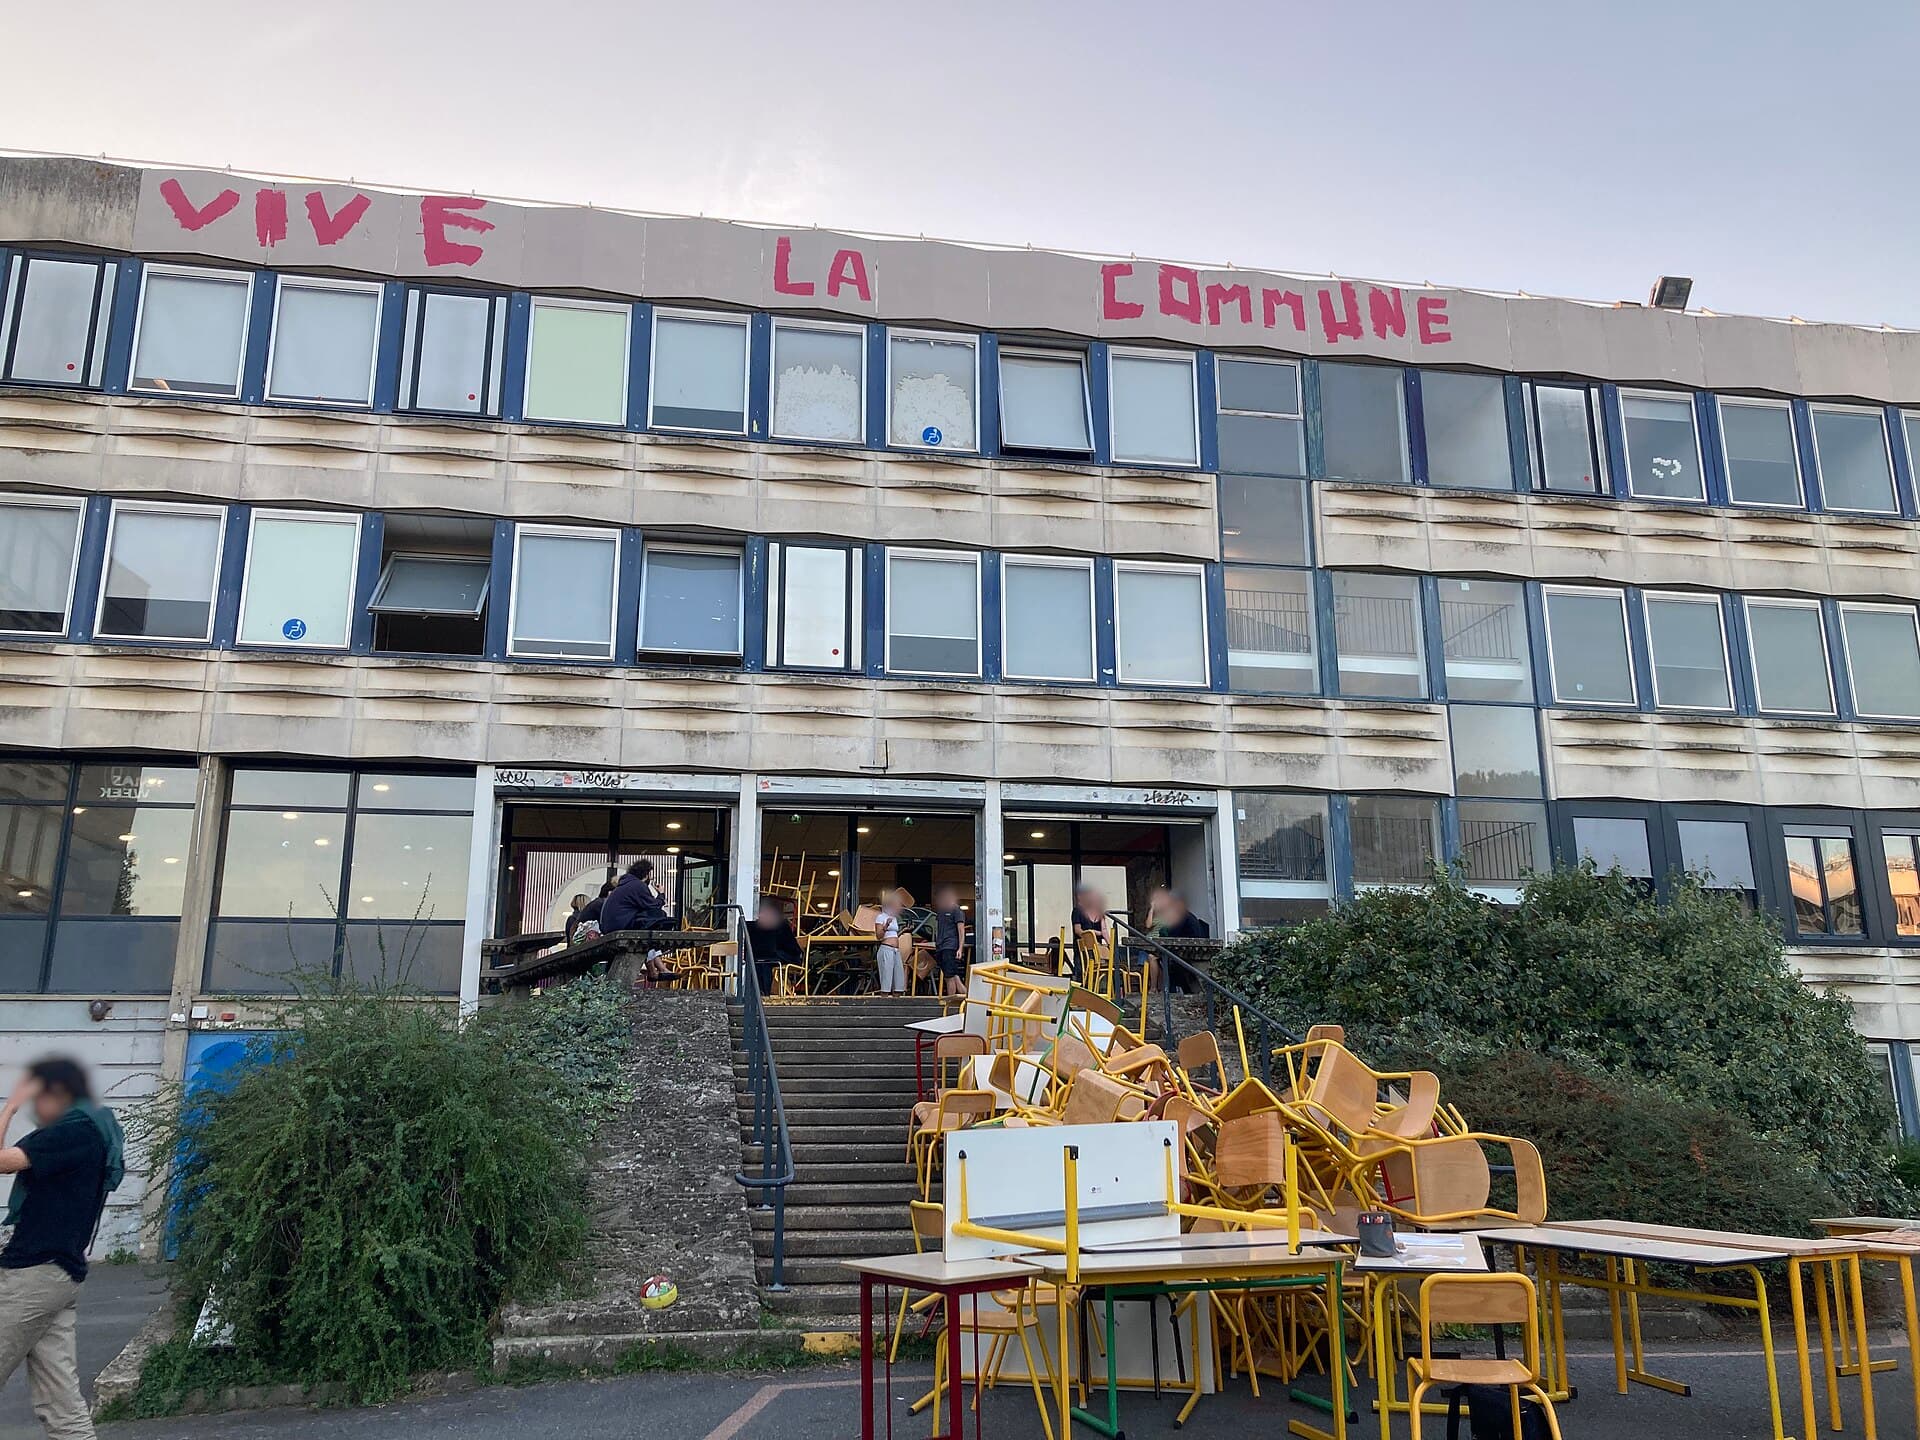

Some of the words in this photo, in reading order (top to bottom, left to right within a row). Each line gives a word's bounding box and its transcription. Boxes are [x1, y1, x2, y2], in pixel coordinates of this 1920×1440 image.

[160, 179, 495, 267] VIVE
[774, 237, 871, 301] LA
[1101, 263, 1452, 345] COMMUNE
